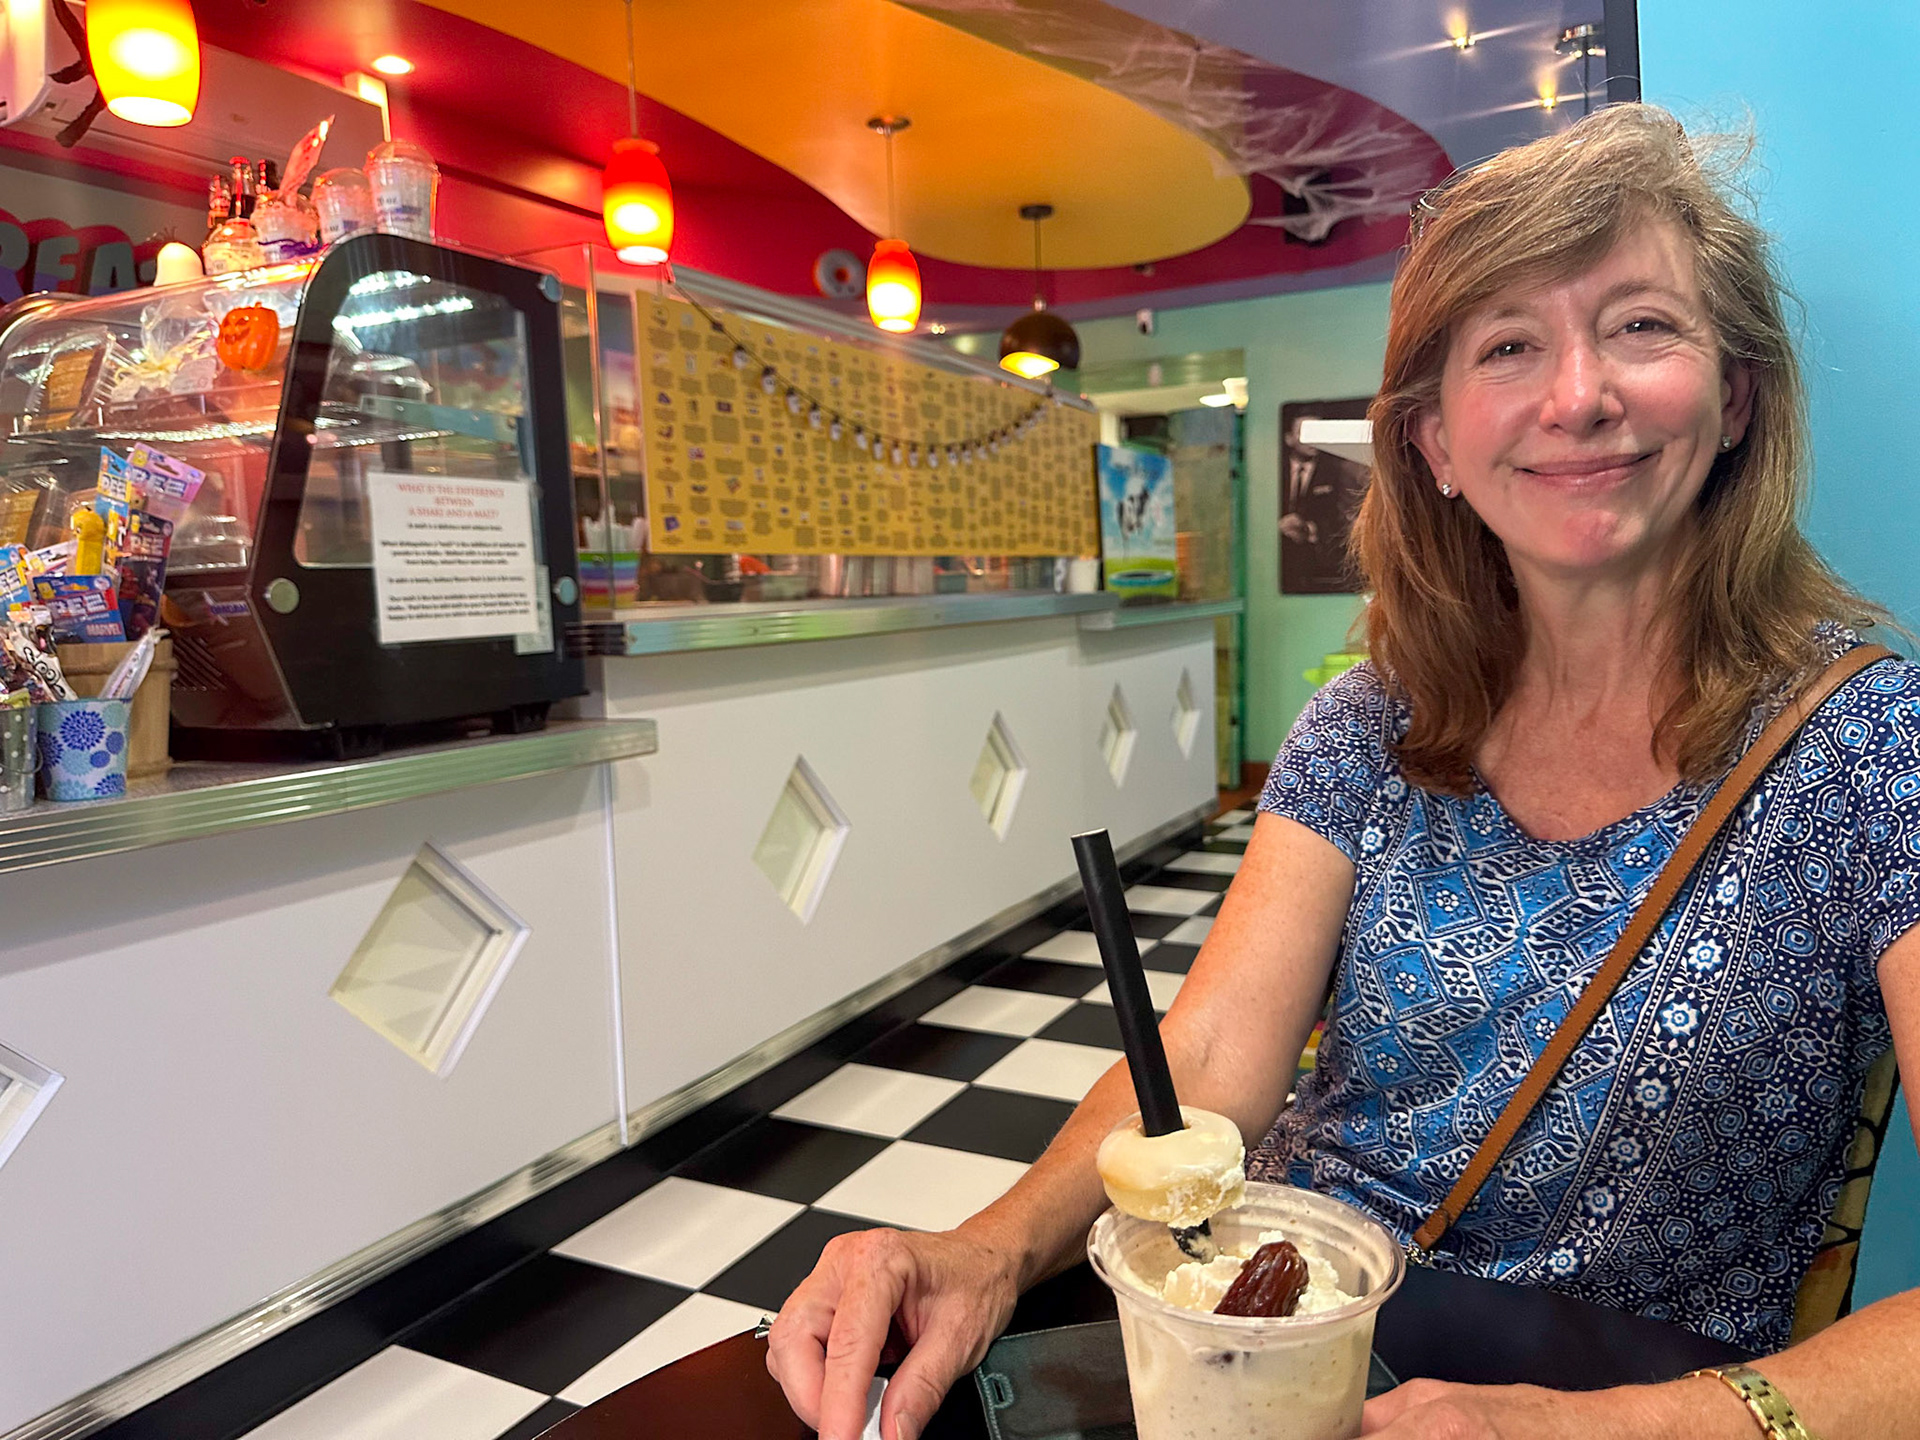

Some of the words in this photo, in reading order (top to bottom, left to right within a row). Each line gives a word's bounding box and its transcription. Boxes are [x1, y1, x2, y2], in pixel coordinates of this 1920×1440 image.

[397, 484, 424, 493] WHAT
[438, 486, 453, 495] THE
[456, 487, 505, 498] DIFFERENCE
[434, 496, 473, 506] BETWEEN
[416, 507, 443, 518] SHAKE
[446, 508, 463, 517] AND
[86, 622, 122, 636] MARVEL
